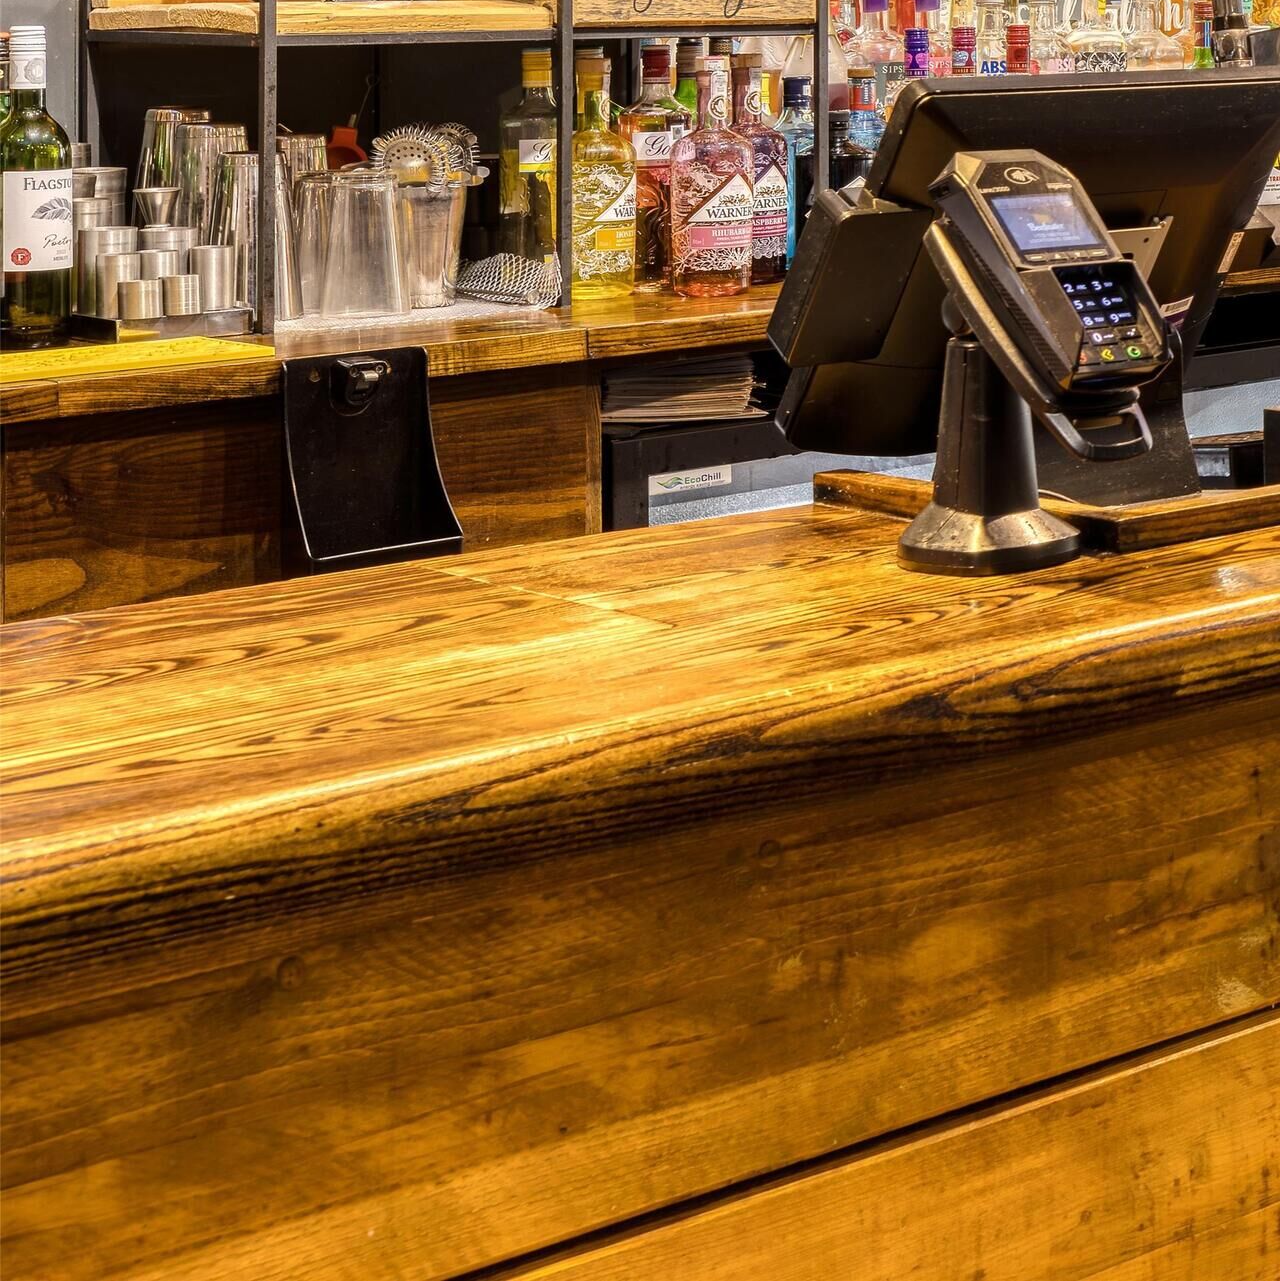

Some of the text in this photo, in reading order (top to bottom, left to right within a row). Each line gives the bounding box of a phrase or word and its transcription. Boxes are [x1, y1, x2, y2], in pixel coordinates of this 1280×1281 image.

[711, 228, 744, 237] RHUBARB
[1064, 281, 1102, 293] 2 3
[1074, 297, 1111, 310] 5 6
[1083, 313, 1119, 325] 8 9
[1093, 332, 1103, 342] 0
[685, 472, 721, 485] EcoChill
